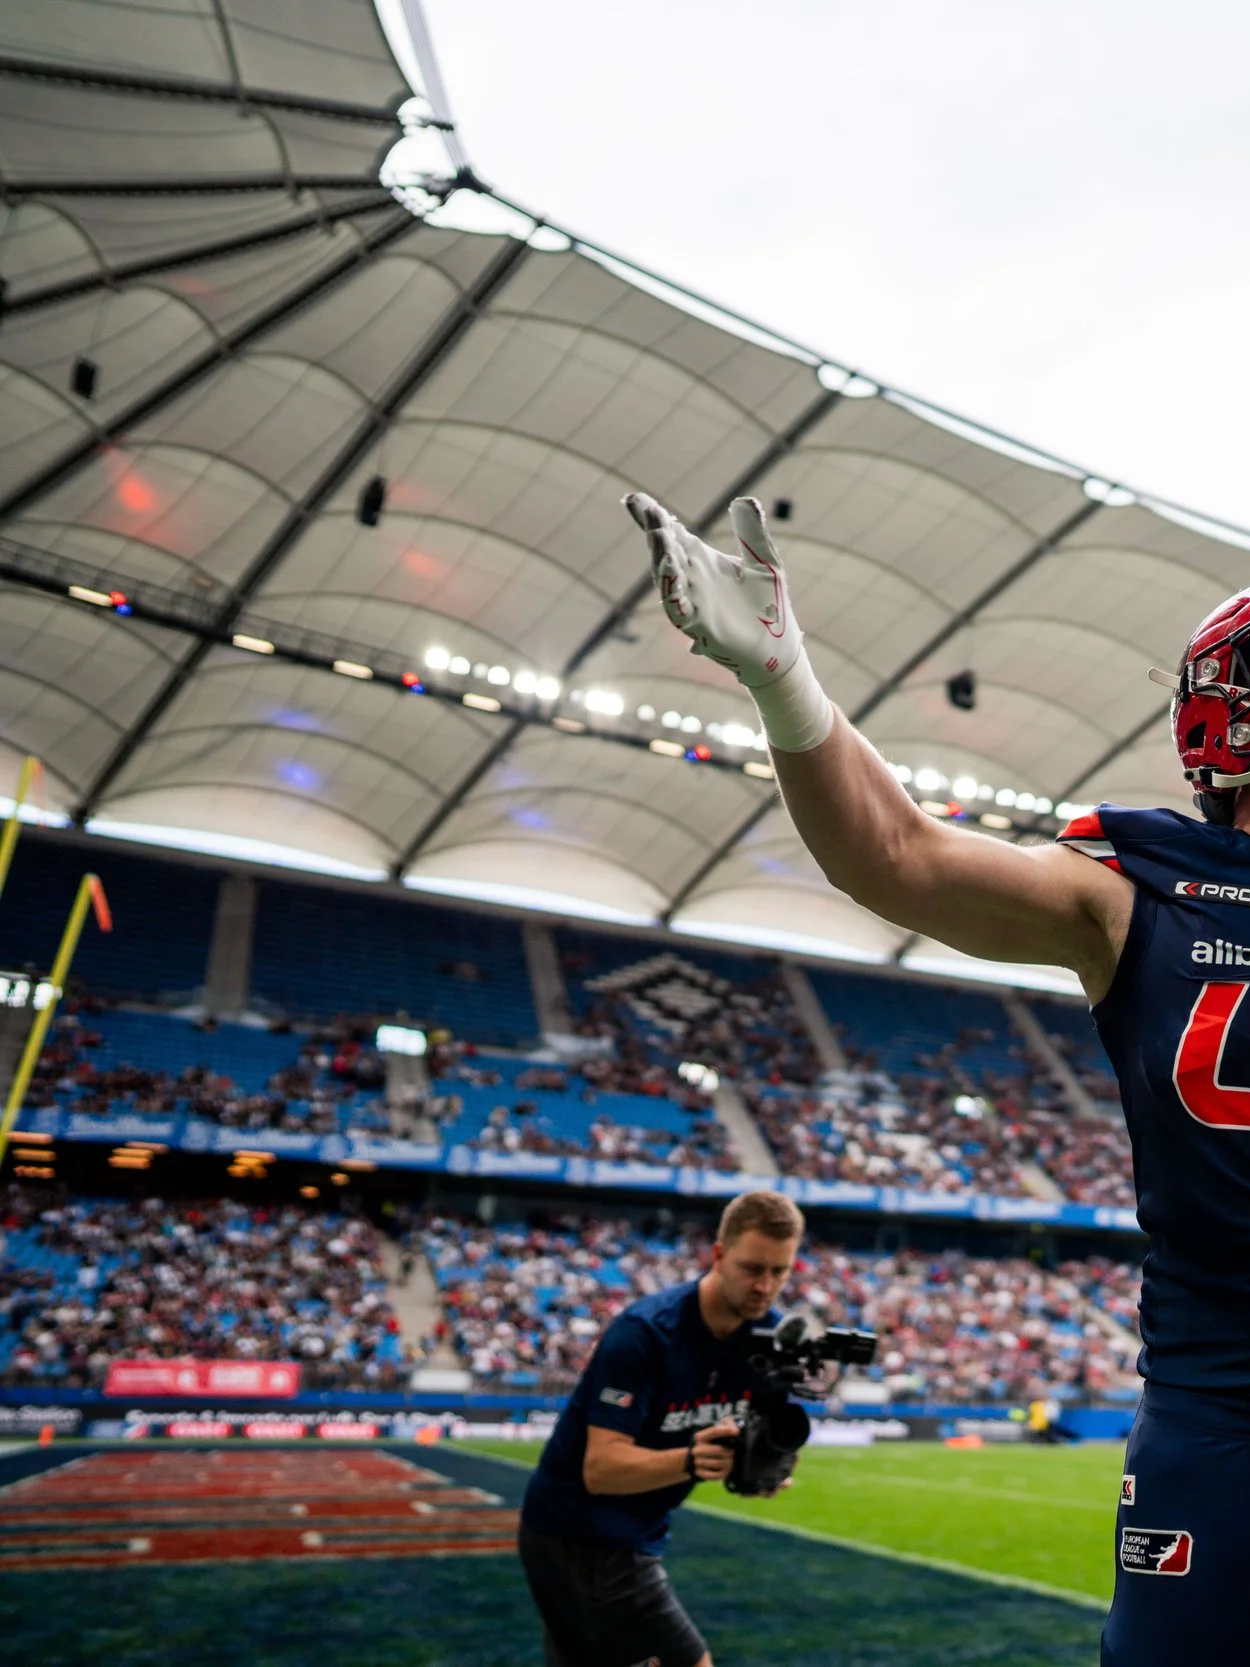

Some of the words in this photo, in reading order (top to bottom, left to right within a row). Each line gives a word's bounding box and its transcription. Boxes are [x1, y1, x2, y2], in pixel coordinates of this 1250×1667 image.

[1124, 1534, 1150, 1545] EUROPEAN
[1123, 1543, 1140, 1553] LEAGUE
[1122, 1553, 1147, 1564] FOOTBALL
